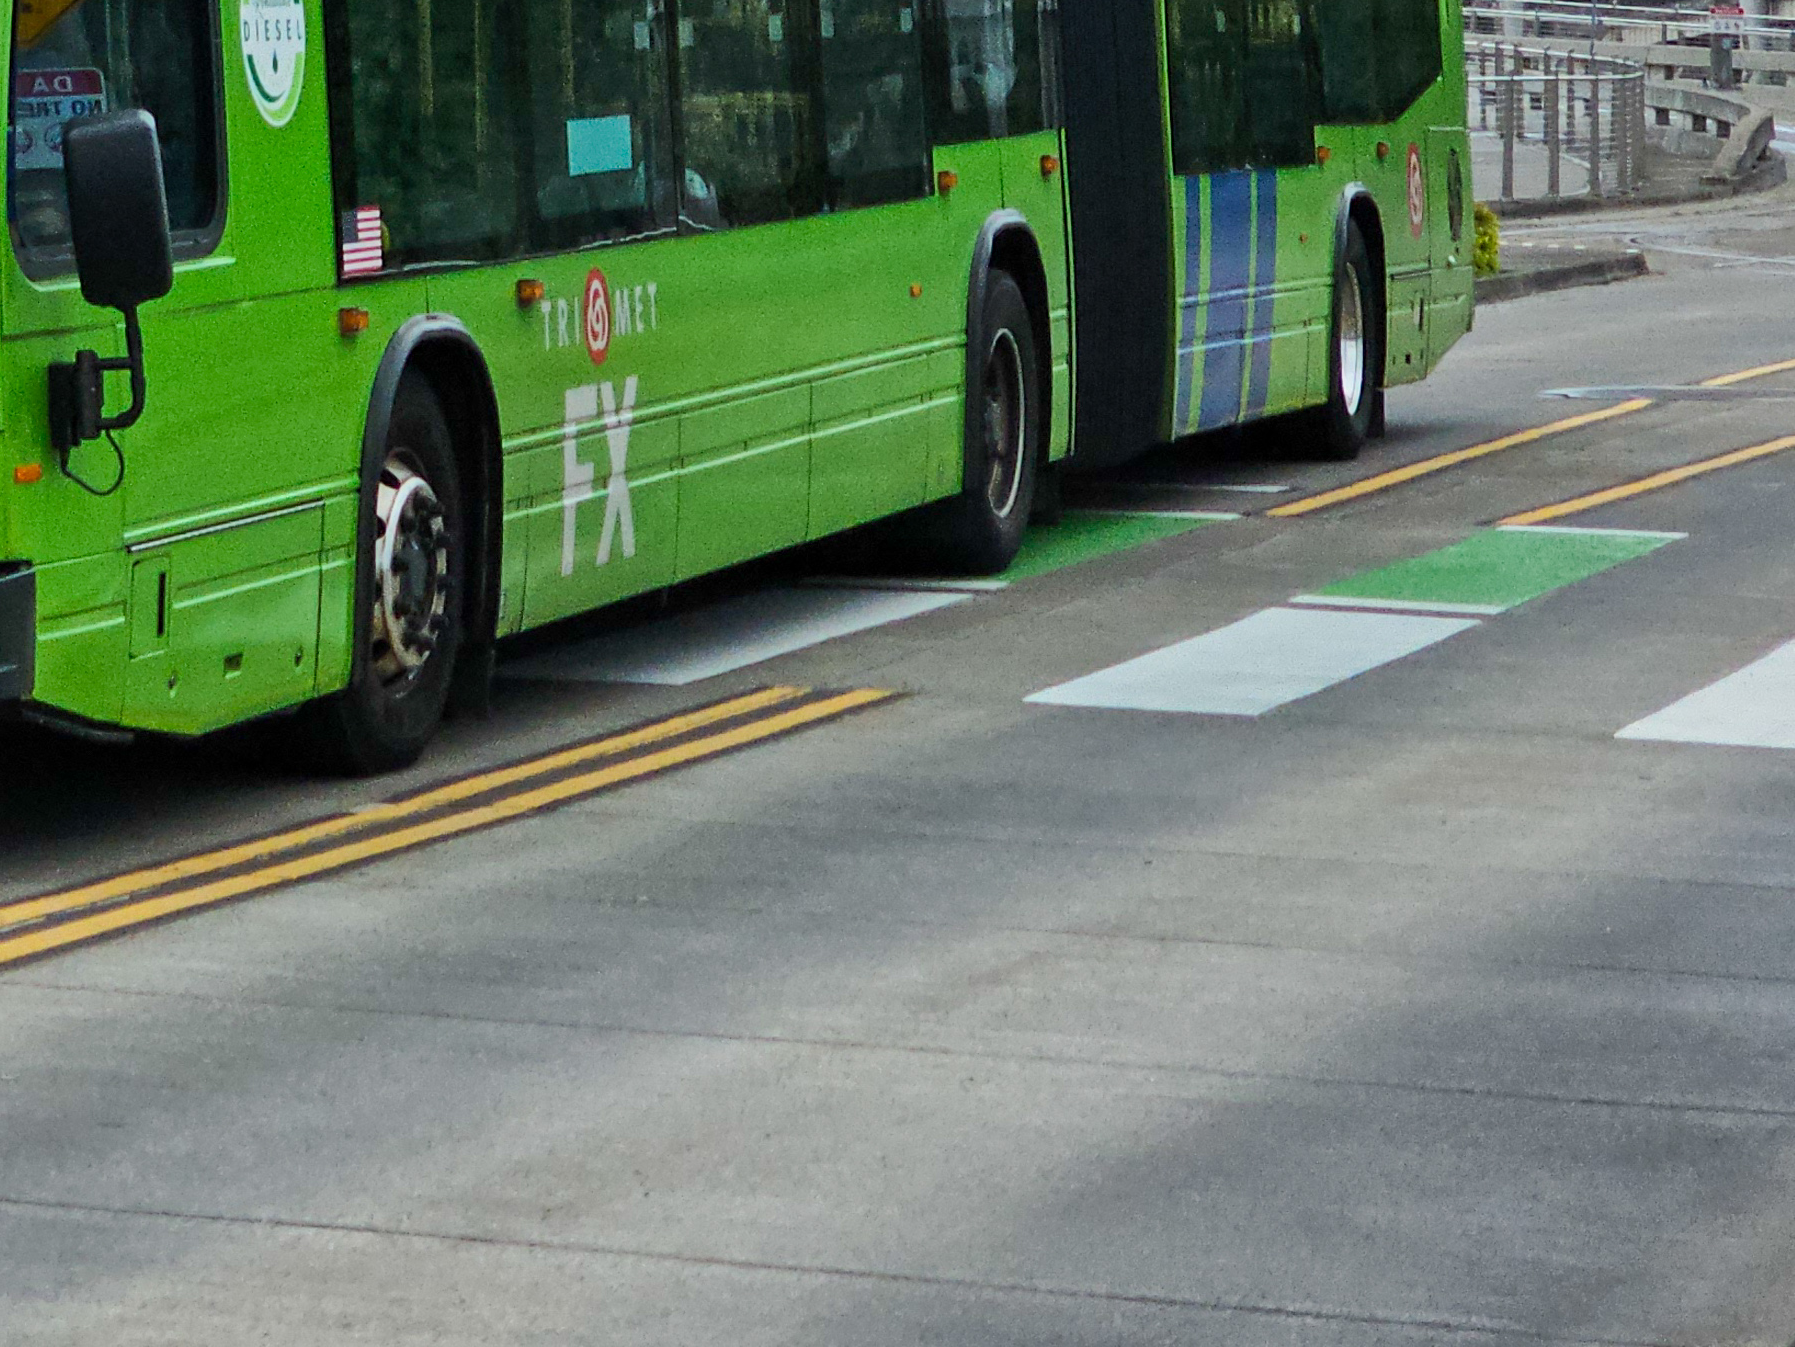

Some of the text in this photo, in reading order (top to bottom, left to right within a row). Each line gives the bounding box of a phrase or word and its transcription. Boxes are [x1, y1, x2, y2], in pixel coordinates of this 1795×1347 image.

[243, 19, 303, 42] DIESEL
[541, 282, 657, 352] TRI MET
[561, 374, 639, 577] FX
